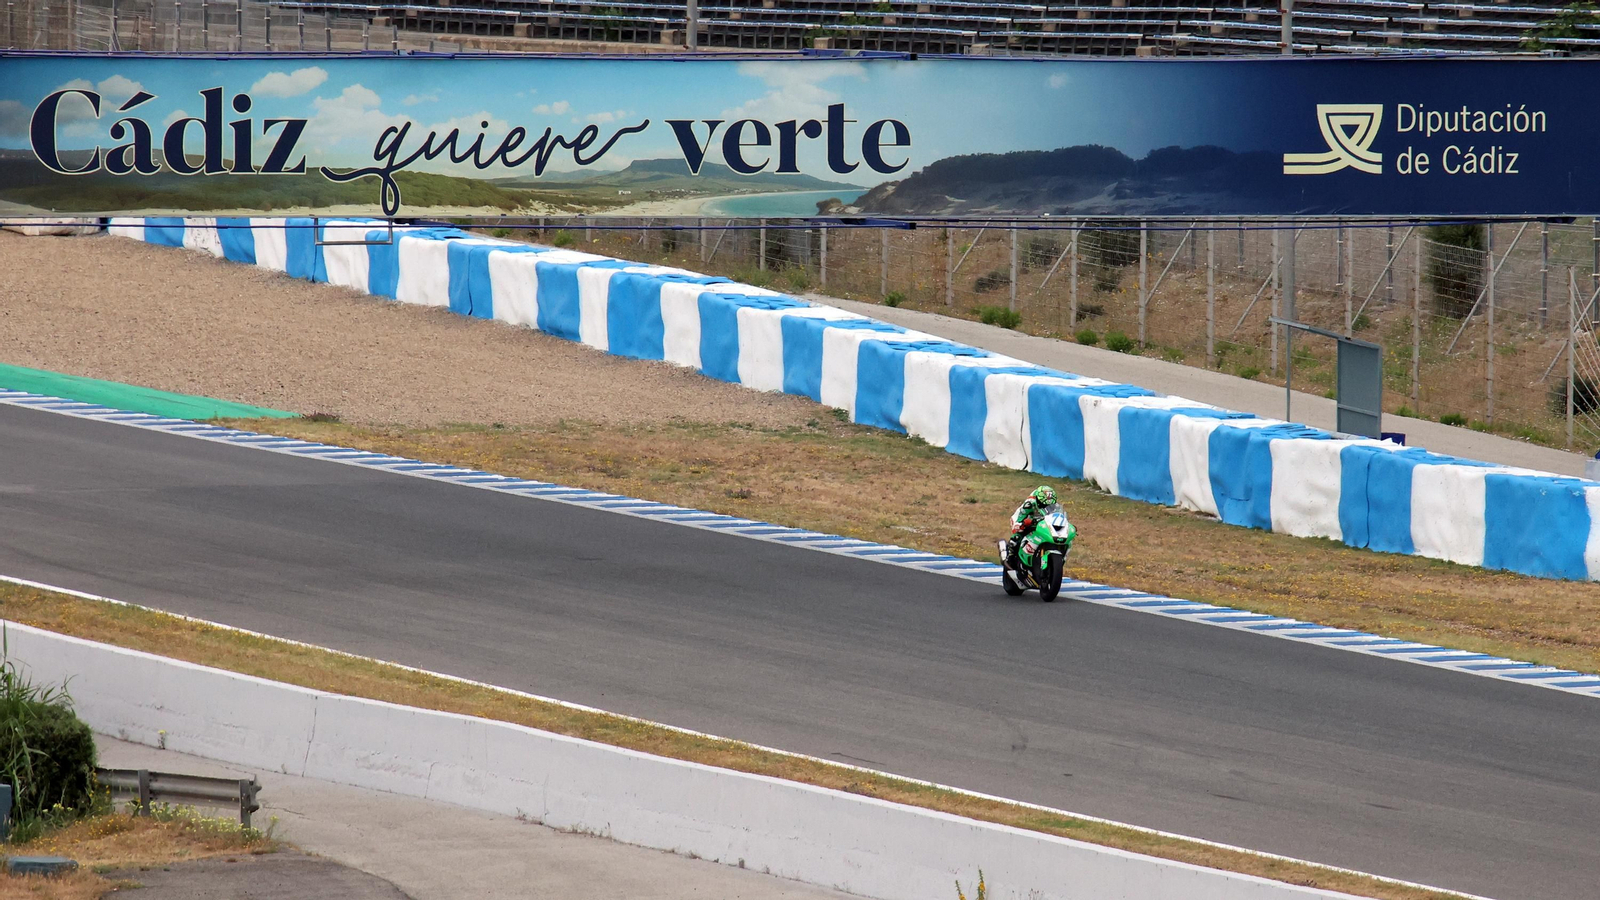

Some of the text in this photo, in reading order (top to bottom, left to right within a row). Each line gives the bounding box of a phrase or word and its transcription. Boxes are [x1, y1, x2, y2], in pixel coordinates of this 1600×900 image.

[1396, 103, 1547, 138] Diputación
[29, 86, 912, 216] Cádiz quiere verte
[1396, 145, 1520, 175] de Cádiz
